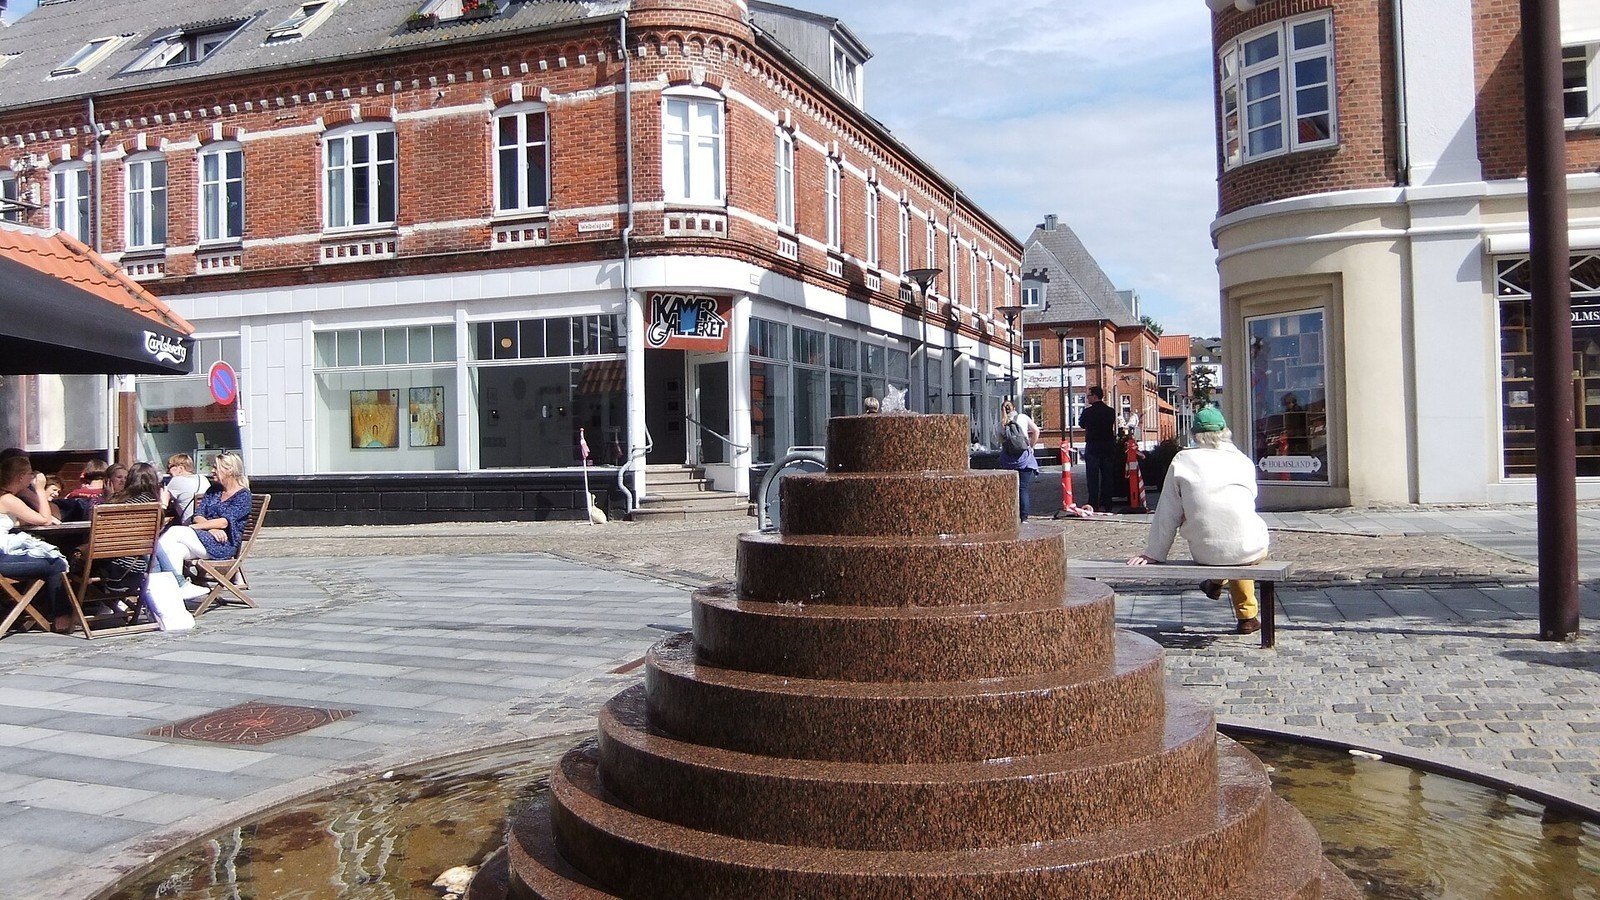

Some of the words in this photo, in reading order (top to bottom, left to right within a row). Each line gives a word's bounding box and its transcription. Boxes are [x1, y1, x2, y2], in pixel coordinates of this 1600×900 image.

[1570, 311, 1600, 321] OLMS
[143, 330, 187, 362] Carlsberg
[1268, 460, 1311, 468] HOLMSLAND
